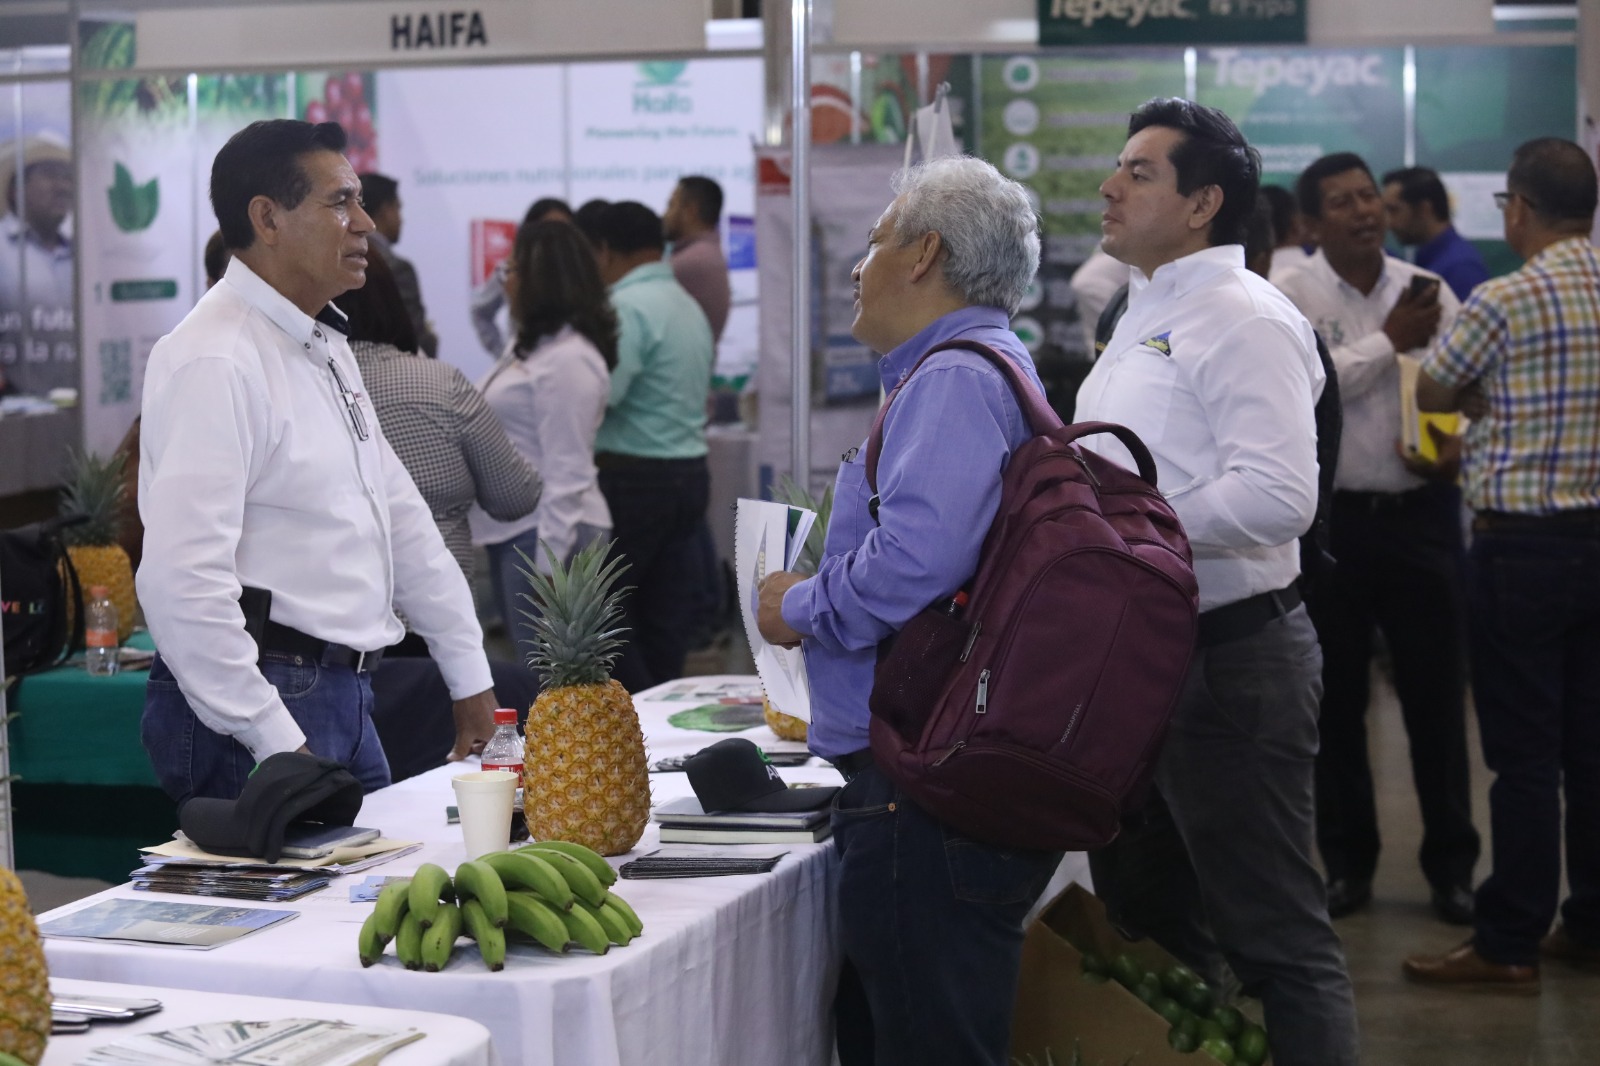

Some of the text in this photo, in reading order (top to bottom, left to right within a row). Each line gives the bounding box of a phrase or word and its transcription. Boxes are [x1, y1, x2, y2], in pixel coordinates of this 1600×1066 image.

[390, 11, 488, 49] HAIFA
[1209, 49, 1382, 96] Tepeyac
[632, 92, 693, 114] Haifa
[412, 168, 510, 186] Soluciones
